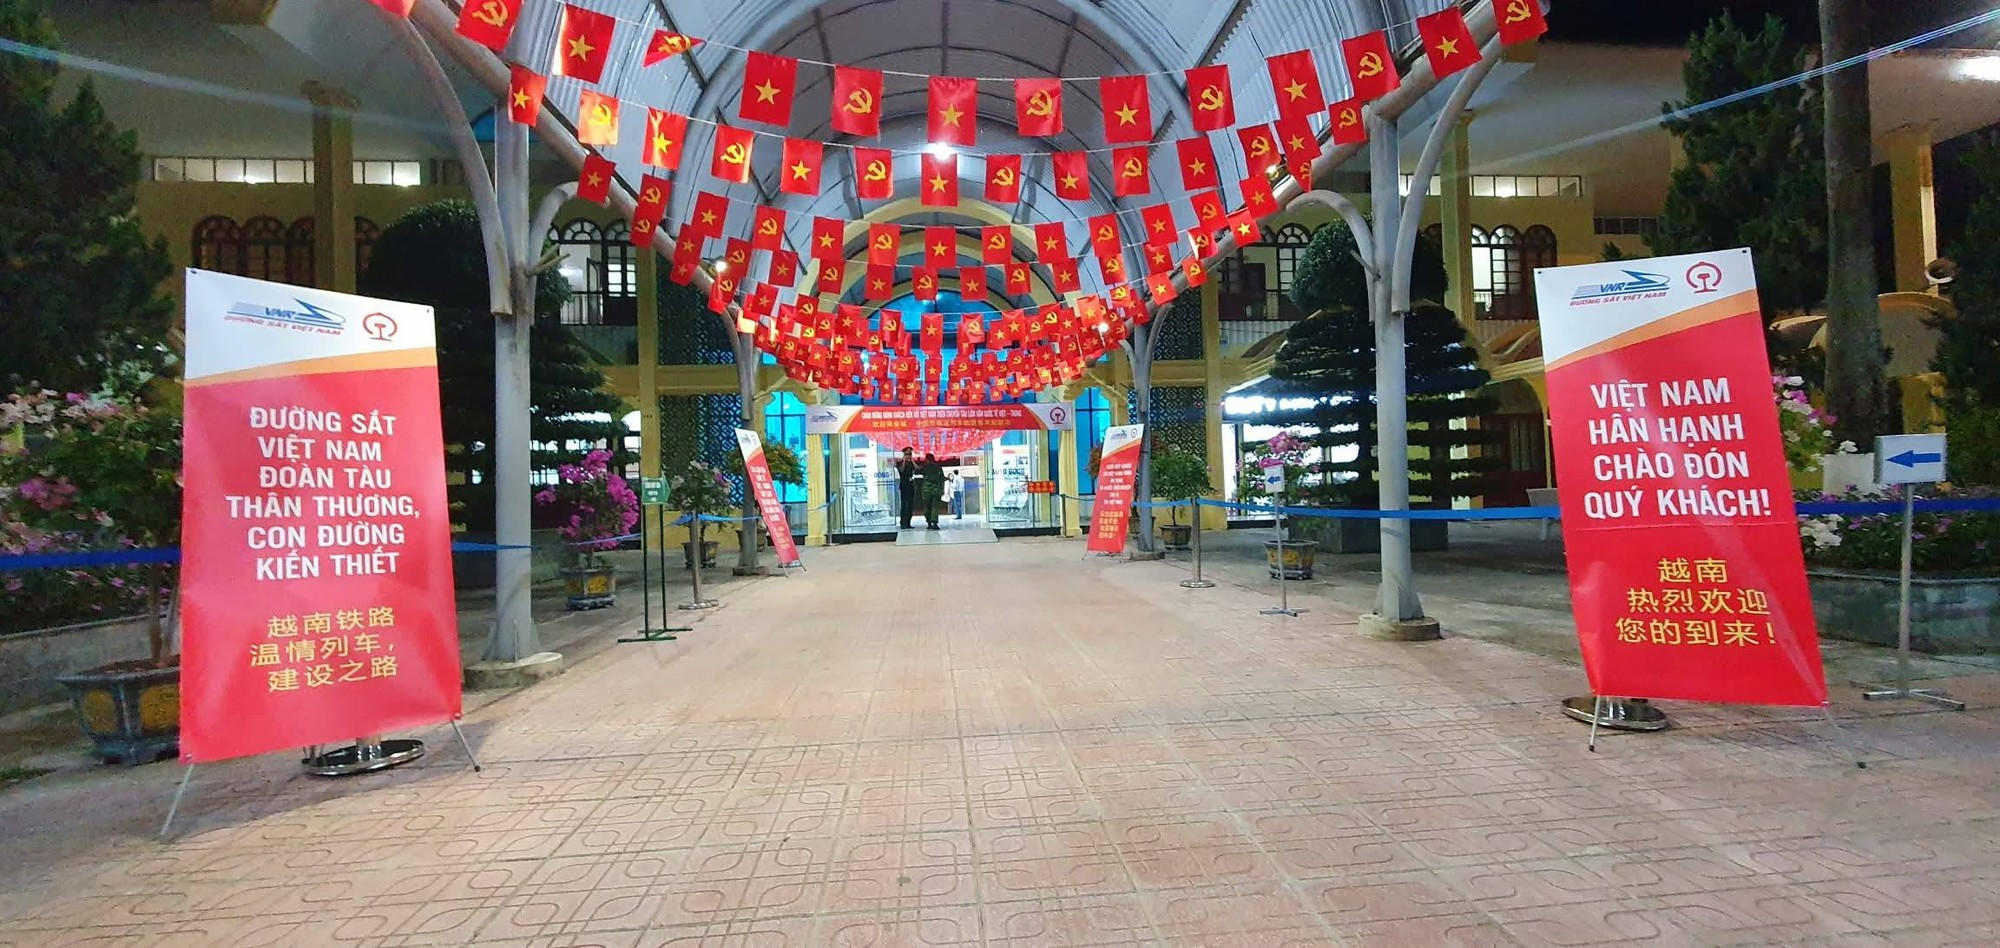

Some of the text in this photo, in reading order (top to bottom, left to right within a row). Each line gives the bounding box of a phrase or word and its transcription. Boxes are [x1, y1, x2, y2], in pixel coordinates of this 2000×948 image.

[1600, 282, 1626, 293] VNR
[1590, 378, 1730, 412] VIỆT NAM
[250, 406, 397, 436] ĐƯỜNG SẮT
[1589, 413, 1743, 447] HÂN HẠNH
[258, 434, 381, 462] VIỆT NAM
[260, 463, 391, 489] ĐOÀN TÀU
[1594, 448, 1749, 480] CHÀO ĐÓN
[226, 492, 419, 518] THÂN THƯƠNG,
[1585, 486, 1771, 519] QUÝ KHÁCH!
[248, 521, 404, 550] CON ĐƯỜNG
[257, 547, 399, 581] KIẾN THIẾT
[1659, 558, 1727, 582] 越南
[1628, 588, 1770, 614] 热烈欢迎
[267, 606, 394, 639] 越南铁路
[1616, 618, 1775, 646] 您的到来!
[250, 629, 398, 667] 温情列车,
[266, 652, 398, 692] 建设之路
